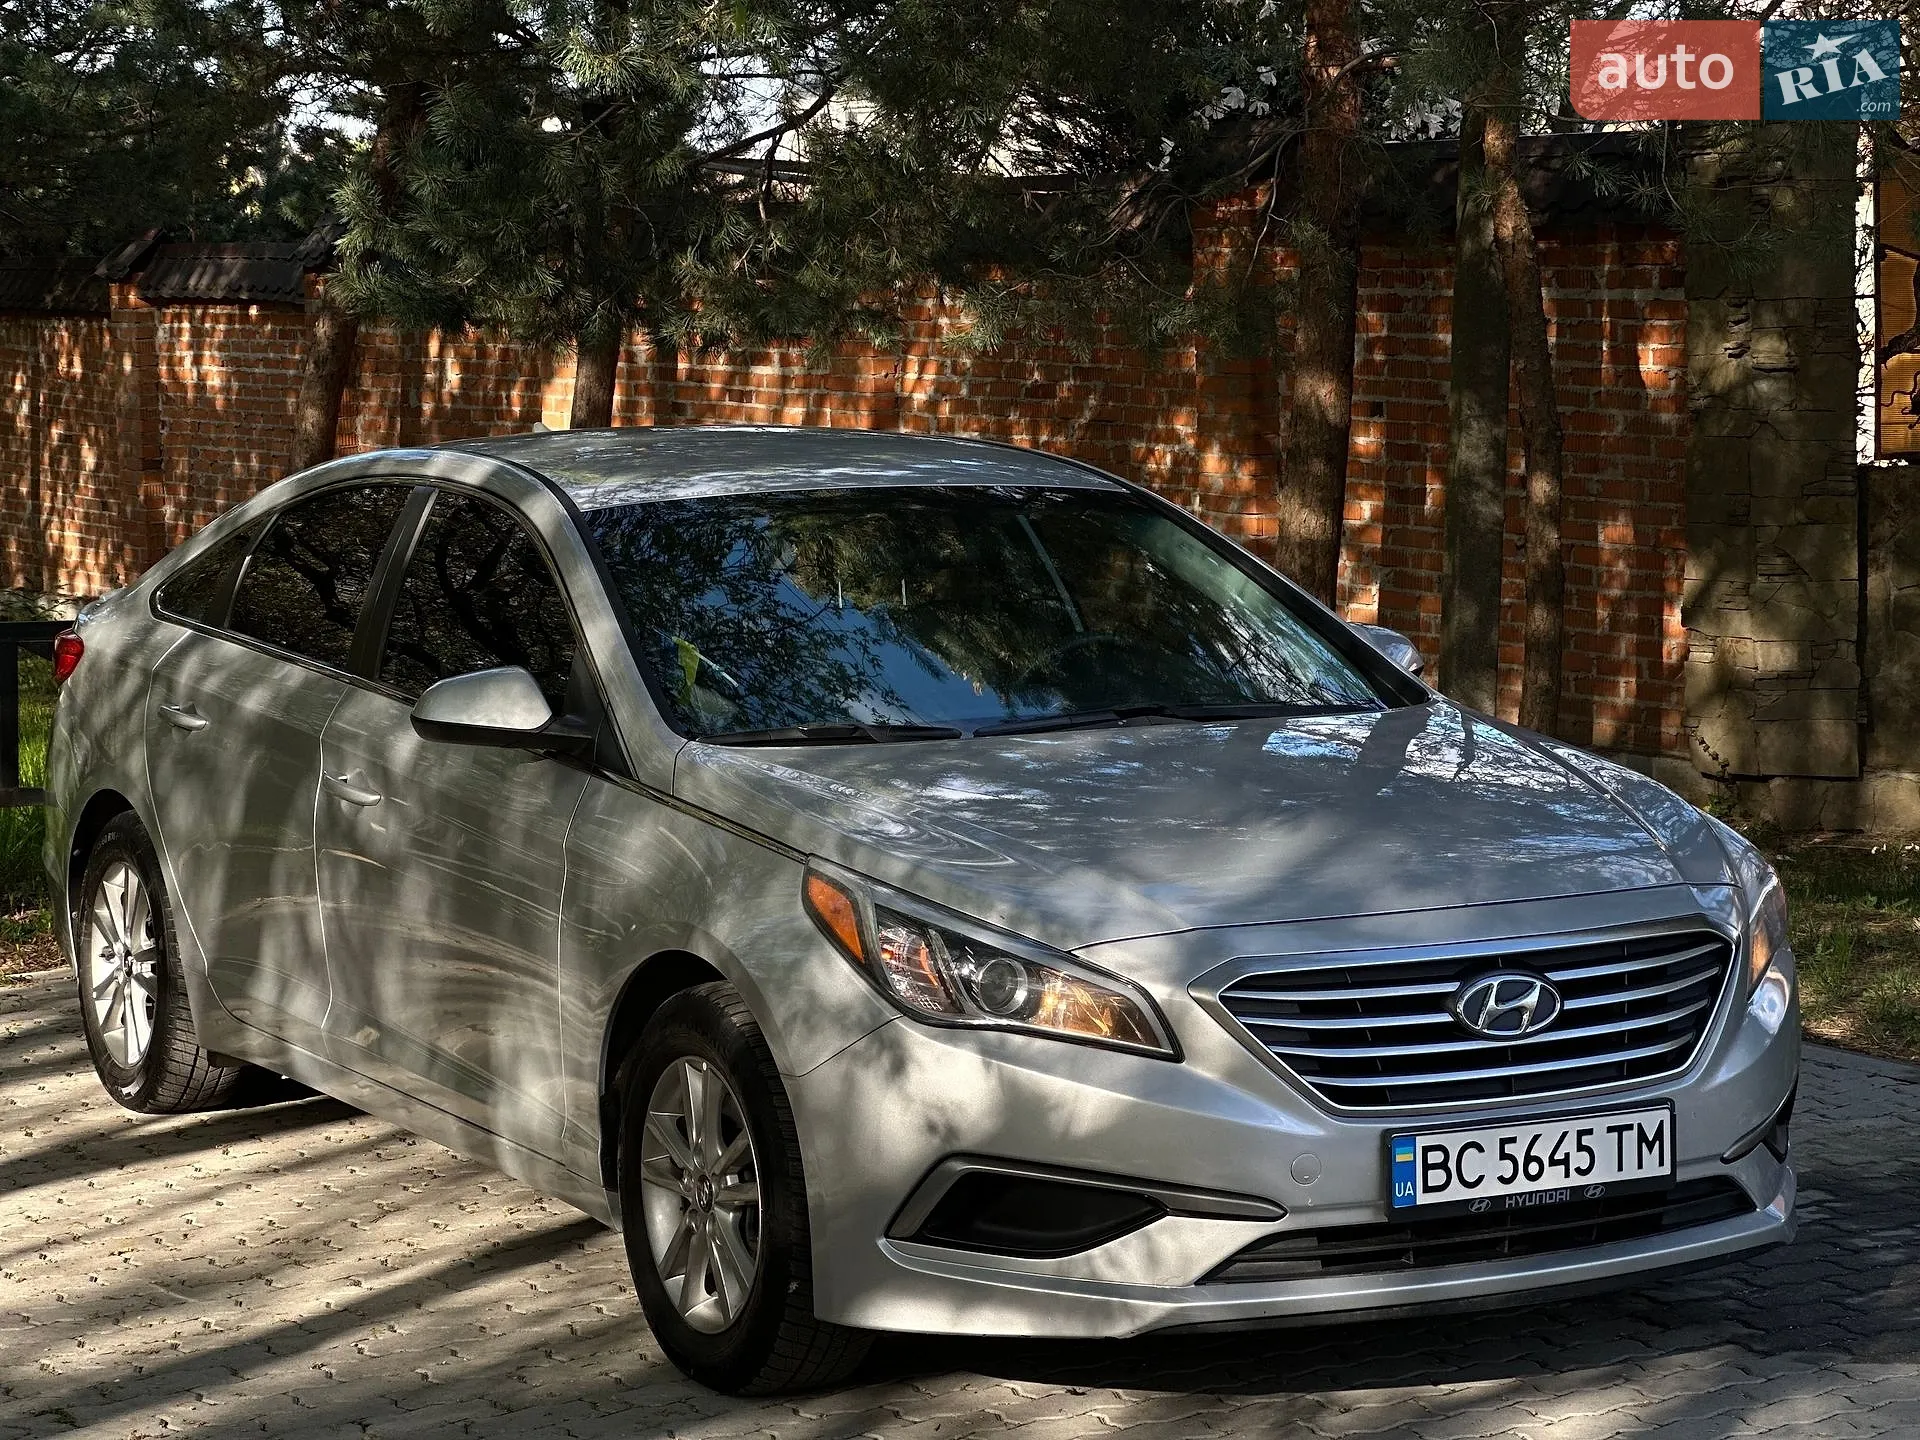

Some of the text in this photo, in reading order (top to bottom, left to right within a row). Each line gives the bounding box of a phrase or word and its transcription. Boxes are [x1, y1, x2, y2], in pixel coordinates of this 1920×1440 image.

[1421, 1119, 1664, 1194] BC 5645 TM
[1395, 1181, 1414, 1197] UA
[1505, 1189, 1570, 1209] HYUNDAI
